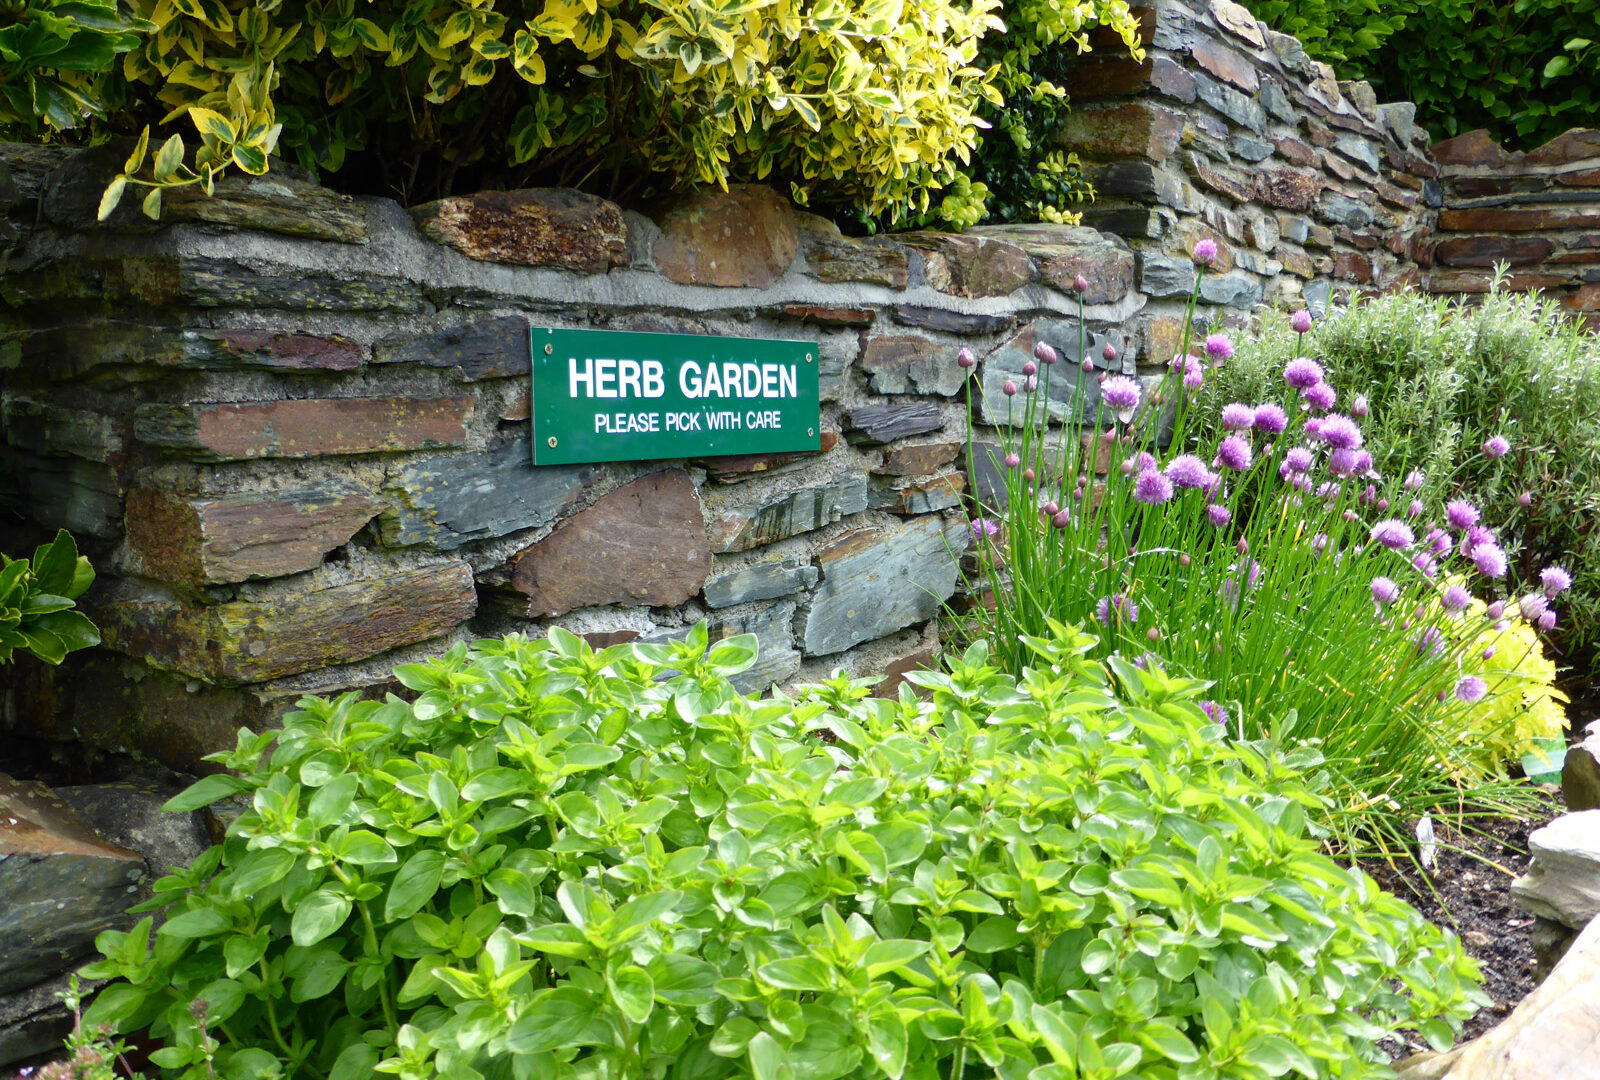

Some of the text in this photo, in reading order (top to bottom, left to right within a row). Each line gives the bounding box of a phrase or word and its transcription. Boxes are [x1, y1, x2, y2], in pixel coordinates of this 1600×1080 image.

[568, 358, 797, 398] HERB GARDEN
[594, 410, 782, 433] PLEASE PICK WITH CARE
